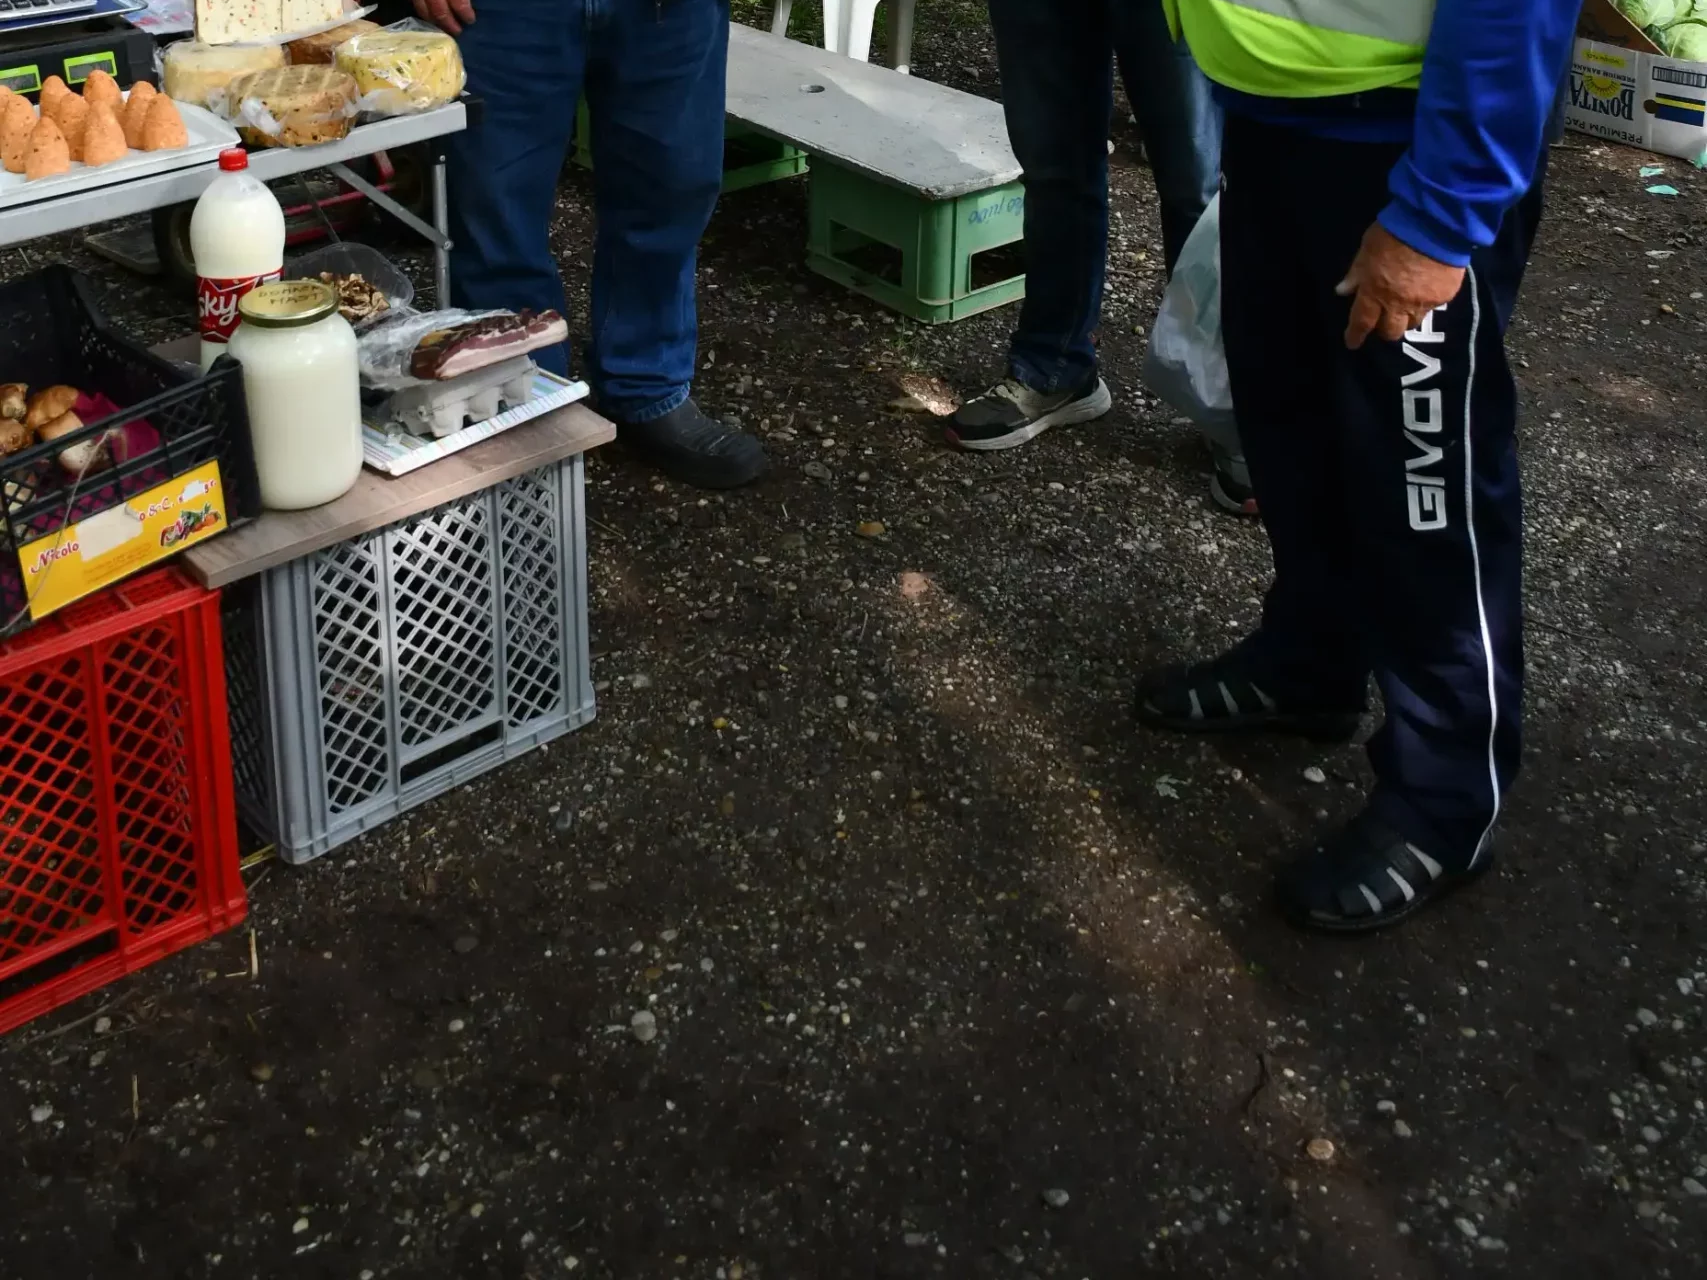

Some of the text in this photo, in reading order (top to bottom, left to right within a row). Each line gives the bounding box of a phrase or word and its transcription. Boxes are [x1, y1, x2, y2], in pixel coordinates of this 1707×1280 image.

[1569, 74, 1636, 122] BONITA
[1589, 123, 1643, 144] PREMIUM
[30, 541, 79, 574] Nicolo
